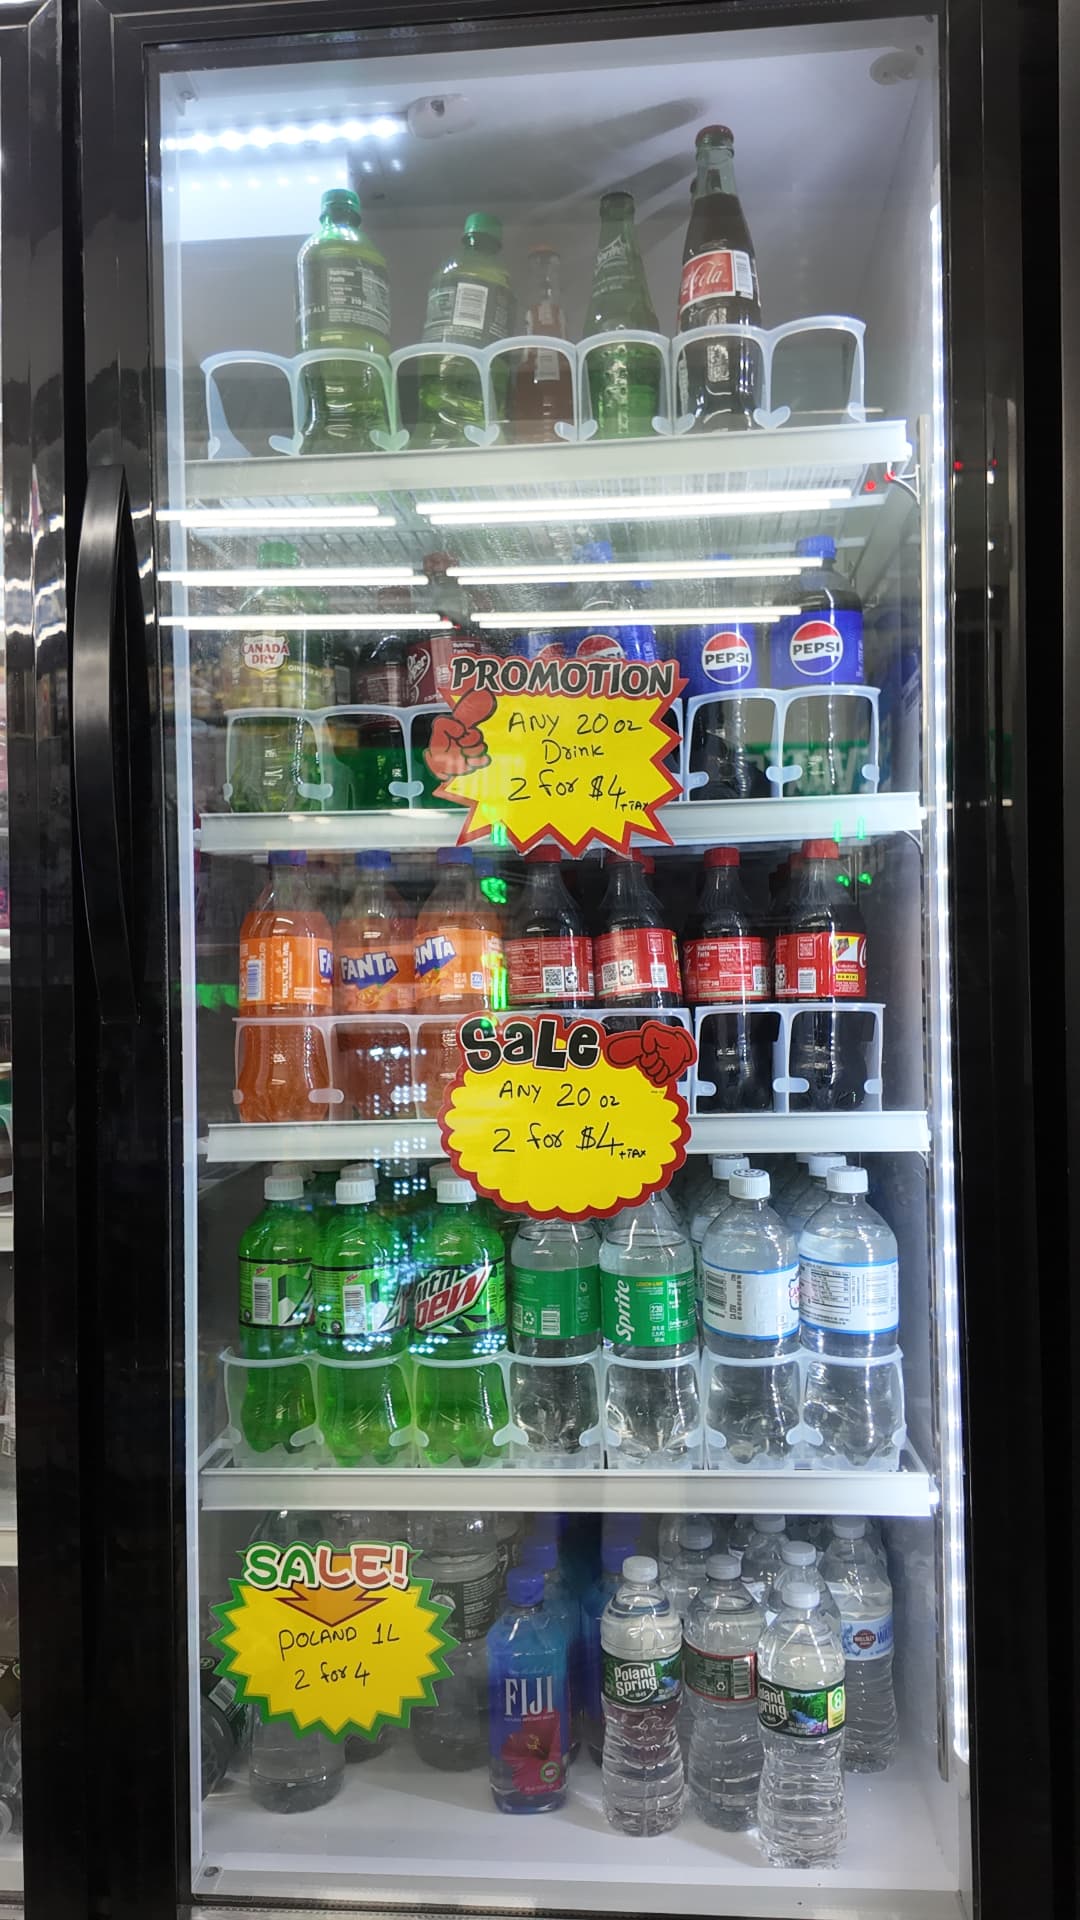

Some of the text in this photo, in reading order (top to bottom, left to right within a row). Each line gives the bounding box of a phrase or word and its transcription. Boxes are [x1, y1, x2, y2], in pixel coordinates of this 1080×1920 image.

[241, 642, 289, 655] CANADA
[252, 654, 276, 665] DRY
[704, 652, 749, 665] PEPSI
[792, 641, 840, 656] PEPSI
[451, 656, 674, 697] PROMOTION
[508, 712, 642, 736] ANY 20 oz
[541, 739, 604, 764] Drink
[508, 777, 531, 802] 2
[538, 768, 579, 797] for
[588, 774, 626, 809] $4
[340, 952, 398, 981] FANTA
[498, 1080, 542, 1103] ANY
[556, 1083, 591, 1107] 20
[492, 1122, 647, 1160] 2 for $4 +TAX
[614, 1280, 635, 1341] Sprite
[244, 1544, 410, 1590] SALE!
[278, 1623, 400, 1661] POLAND 1L
[294, 1661, 371, 1690] 2 for 4
[614, 1663, 656, 1681] Poland
[504, 1675, 553, 1716] FIJI
[615, 1677, 658, 1697] Spring
